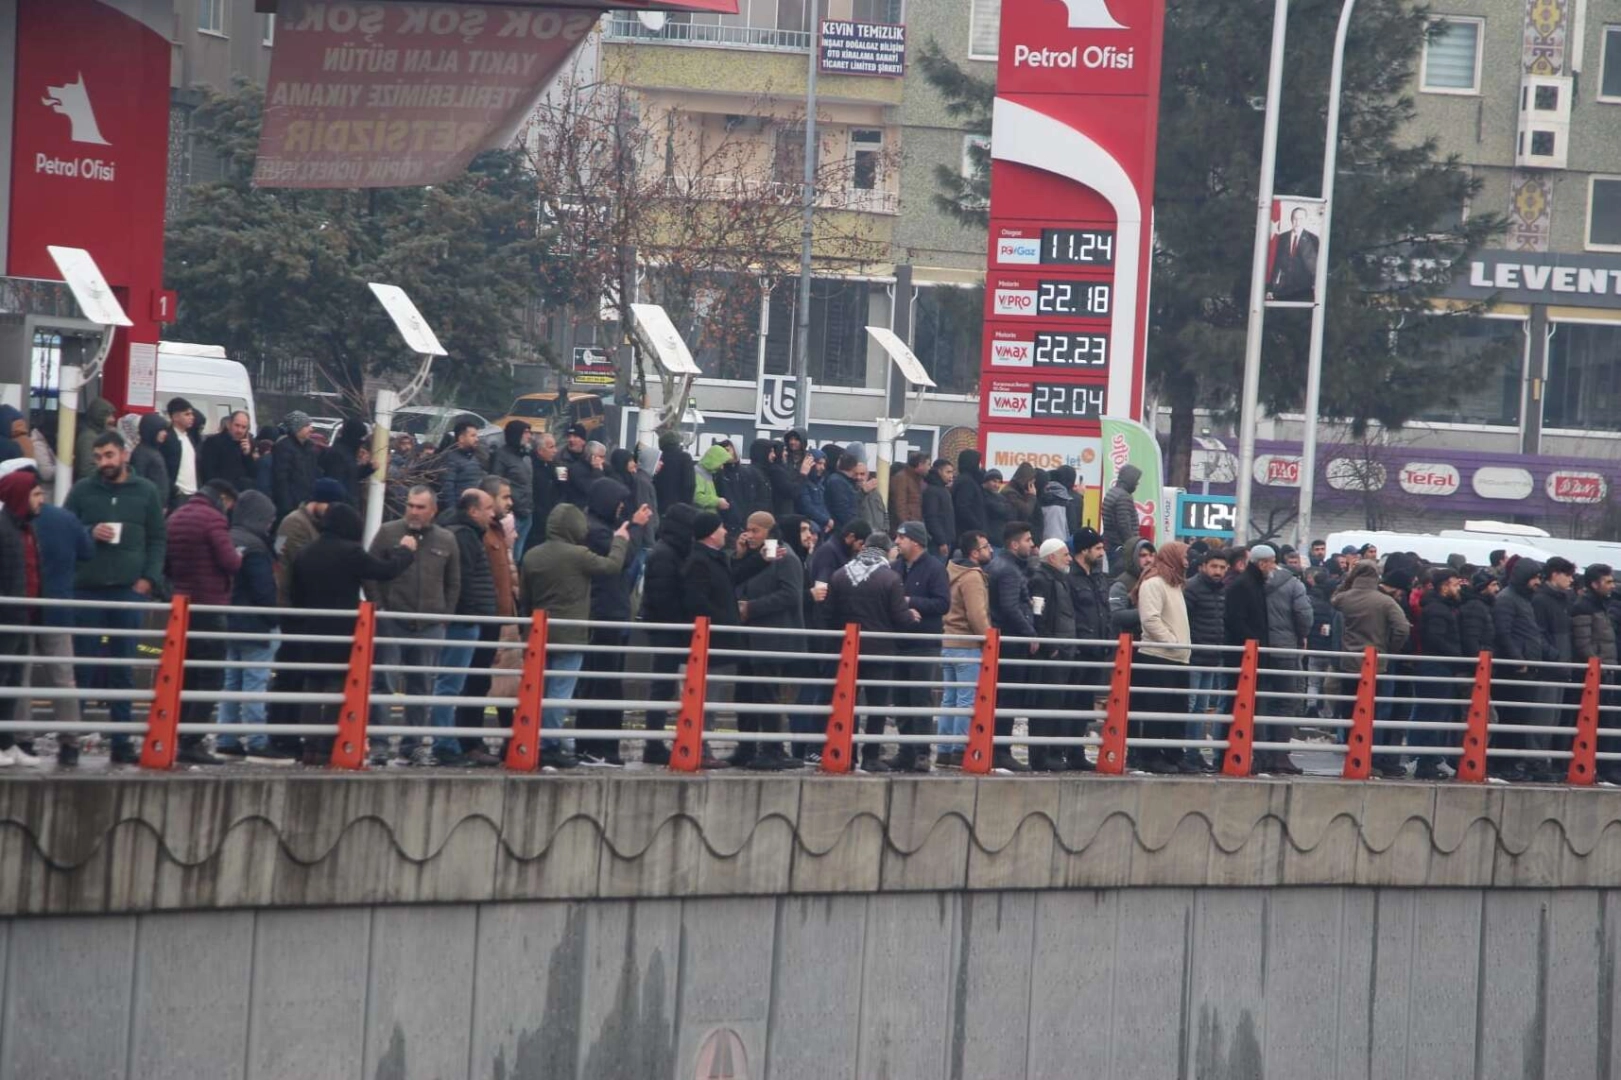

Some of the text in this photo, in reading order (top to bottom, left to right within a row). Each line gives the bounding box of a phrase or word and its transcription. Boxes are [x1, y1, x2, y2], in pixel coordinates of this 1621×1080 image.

[822, 21, 904, 40] KEVİN TEMİZLİK
[1014, 44, 1134, 69] Petrol Ofisi
[35, 152, 115, 181] Petrol Ofisi
[1052, 233, 1112, 261] 11.24
[160, 296, 168, 317] 1
[1040, 284, 1109, 313] 22.18
[1036, 335, 1106, 365] 22.23
[1034, 386, 1103, 415] 22.04
[1405, 470, 1456, 487] Tefal
